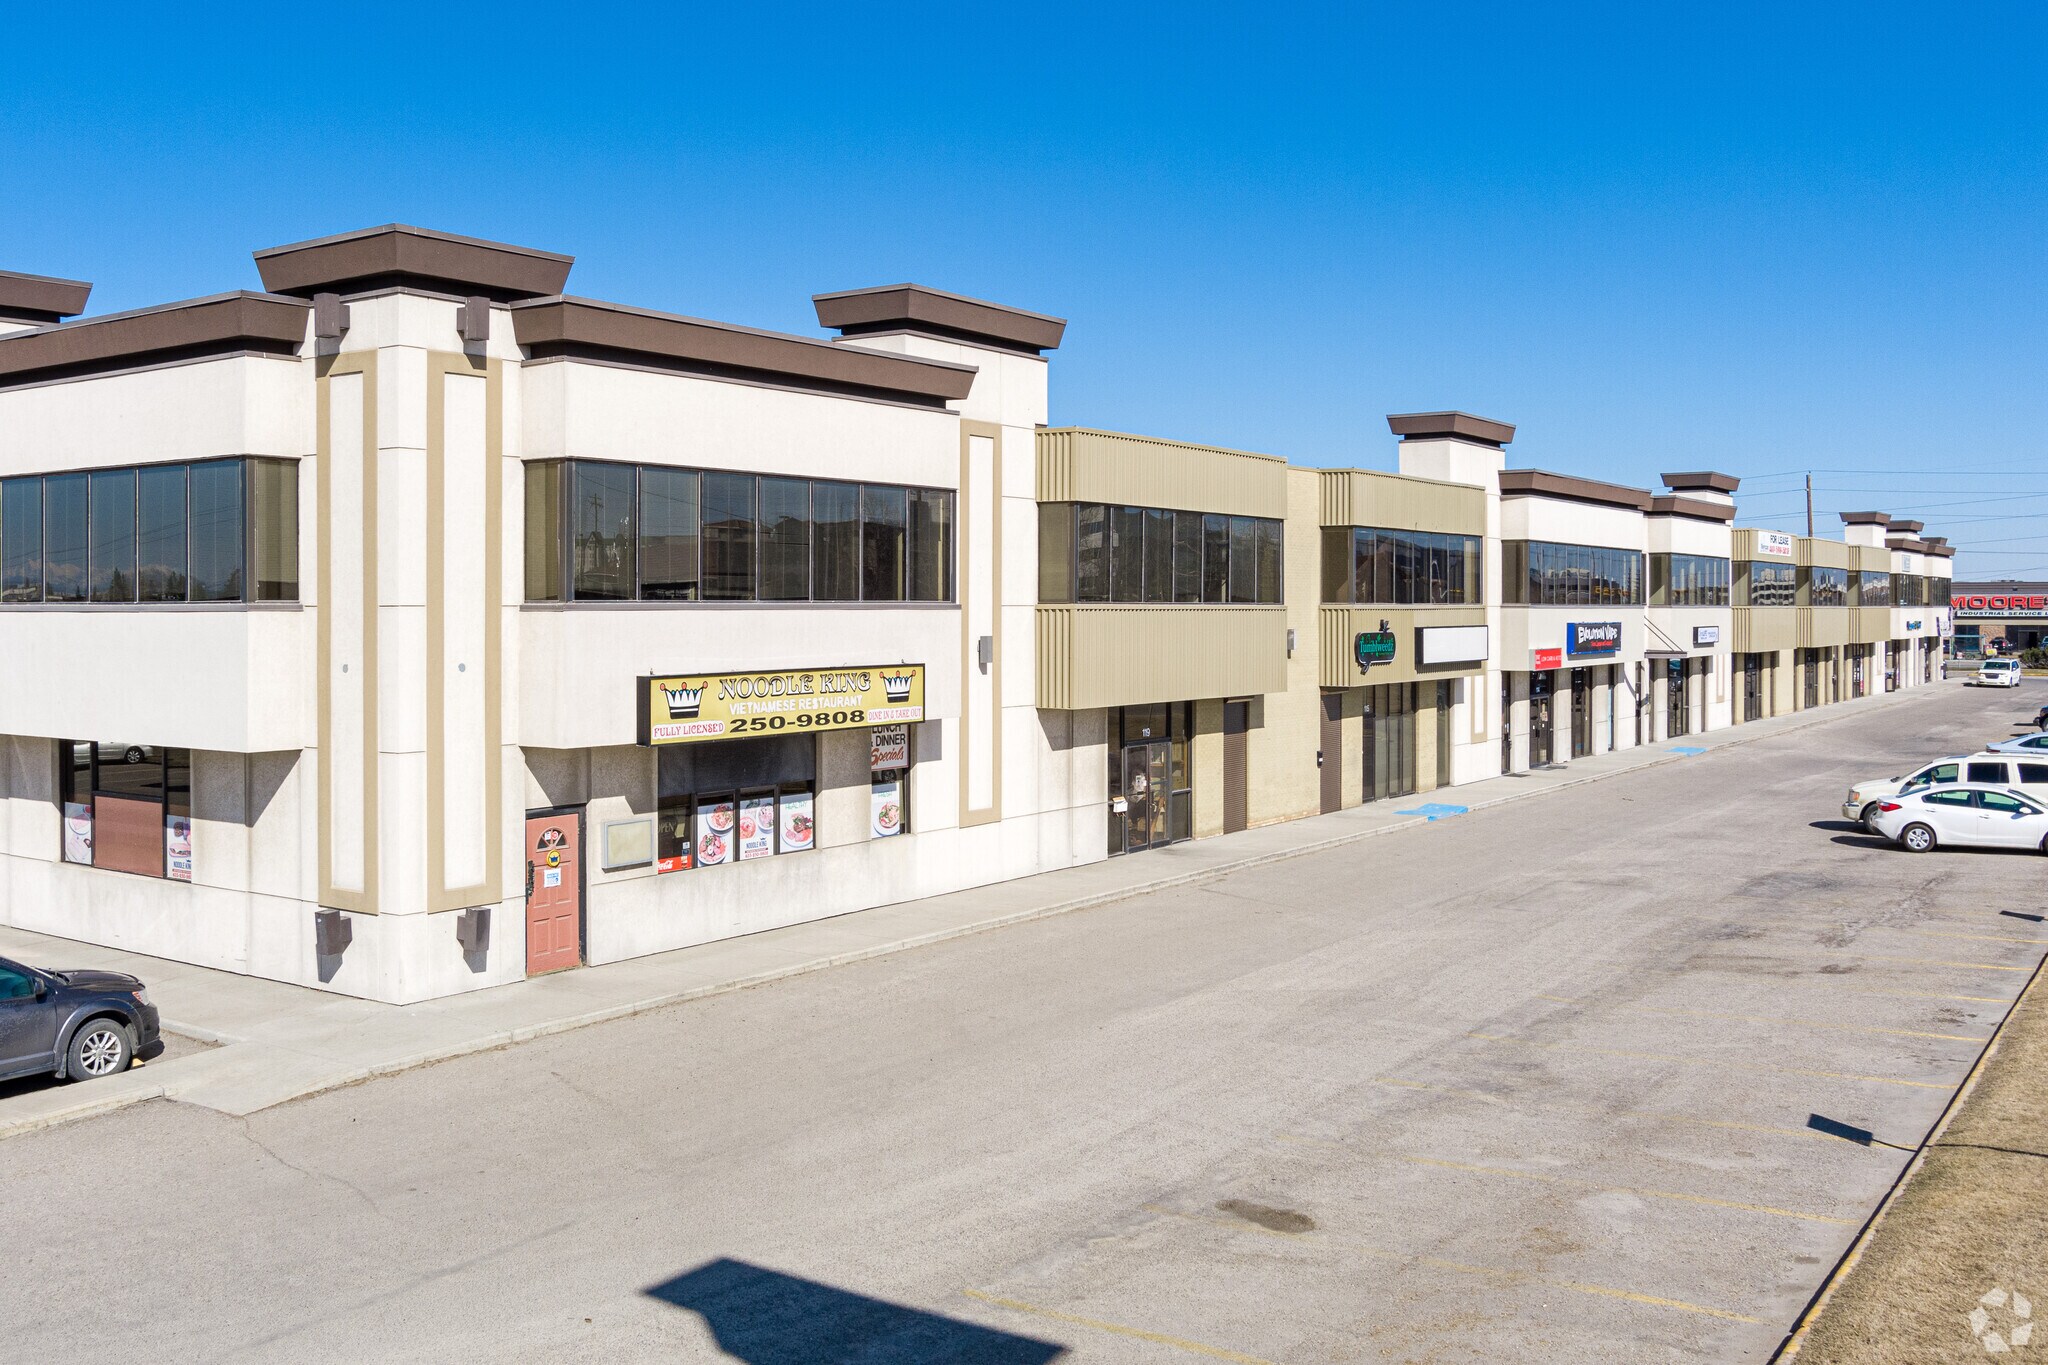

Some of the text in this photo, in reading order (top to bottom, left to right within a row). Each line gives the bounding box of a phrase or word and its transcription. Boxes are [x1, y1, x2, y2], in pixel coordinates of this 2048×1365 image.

[1951, 595, 2048, 609] MOORE
[718, 672, 871, 700] NOODLE KING
[729, 694, 863, 716] VIETNAMESE RESTAURANT
[730, 710, 865, 733] 250-9808
[868, 710, 882, 721] DINE
[883, 711, 891, 719] IN
[896, 708, 909, 718] TAKE
[910, 707, 921, 717] OUT
[653, 722, 724, 738] FULLY LICENSED
[872, 725, 901, 733] LUNCH
[875, 733, 906, 747] DINNER
[871, 746, 904, 766] Specials
